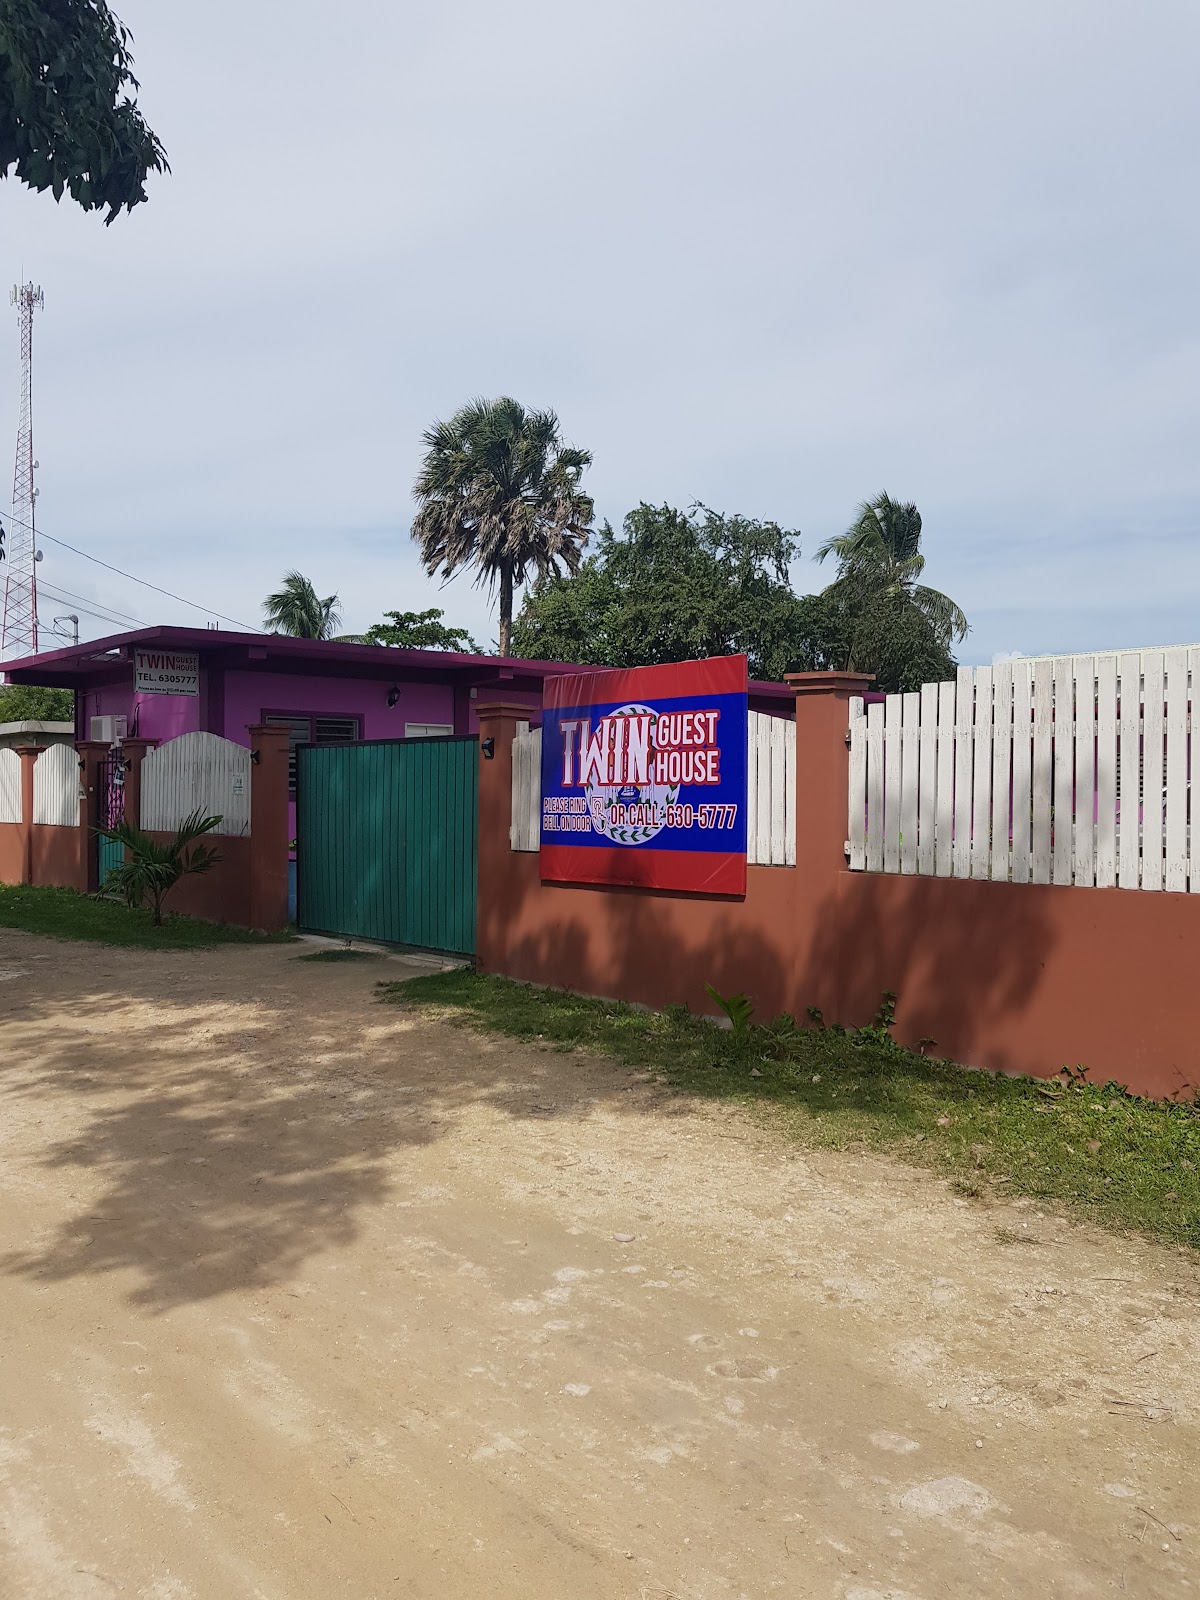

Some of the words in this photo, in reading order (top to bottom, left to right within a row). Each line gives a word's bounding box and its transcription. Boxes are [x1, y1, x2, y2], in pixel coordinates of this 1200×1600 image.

[137, 653, 175, 671] TWIN
[175, 656, 197, 664] GUEST
[175, 664, 197, 672] HOUSE
[138, 672, 157, 681] TEL.
[158, 674, 197, 684] 6305777
[657, 711, 719, 747] GUEST
[560, 715, 652, 786] TWIN
[656, 749, 720, 784] HOUSE
[544, 797, 568, 813] PLEASE
[569, 797, 587, 813] RING
[543, 815, 560, 830] BELL
[561, 815, 571, 831] ON
[572, 815, 592, 832] DOOR
[610, 804, 626, 825] OR
[628, 804, 662, 826] CALL:
[665, 804, 737, 829] 630-5777
